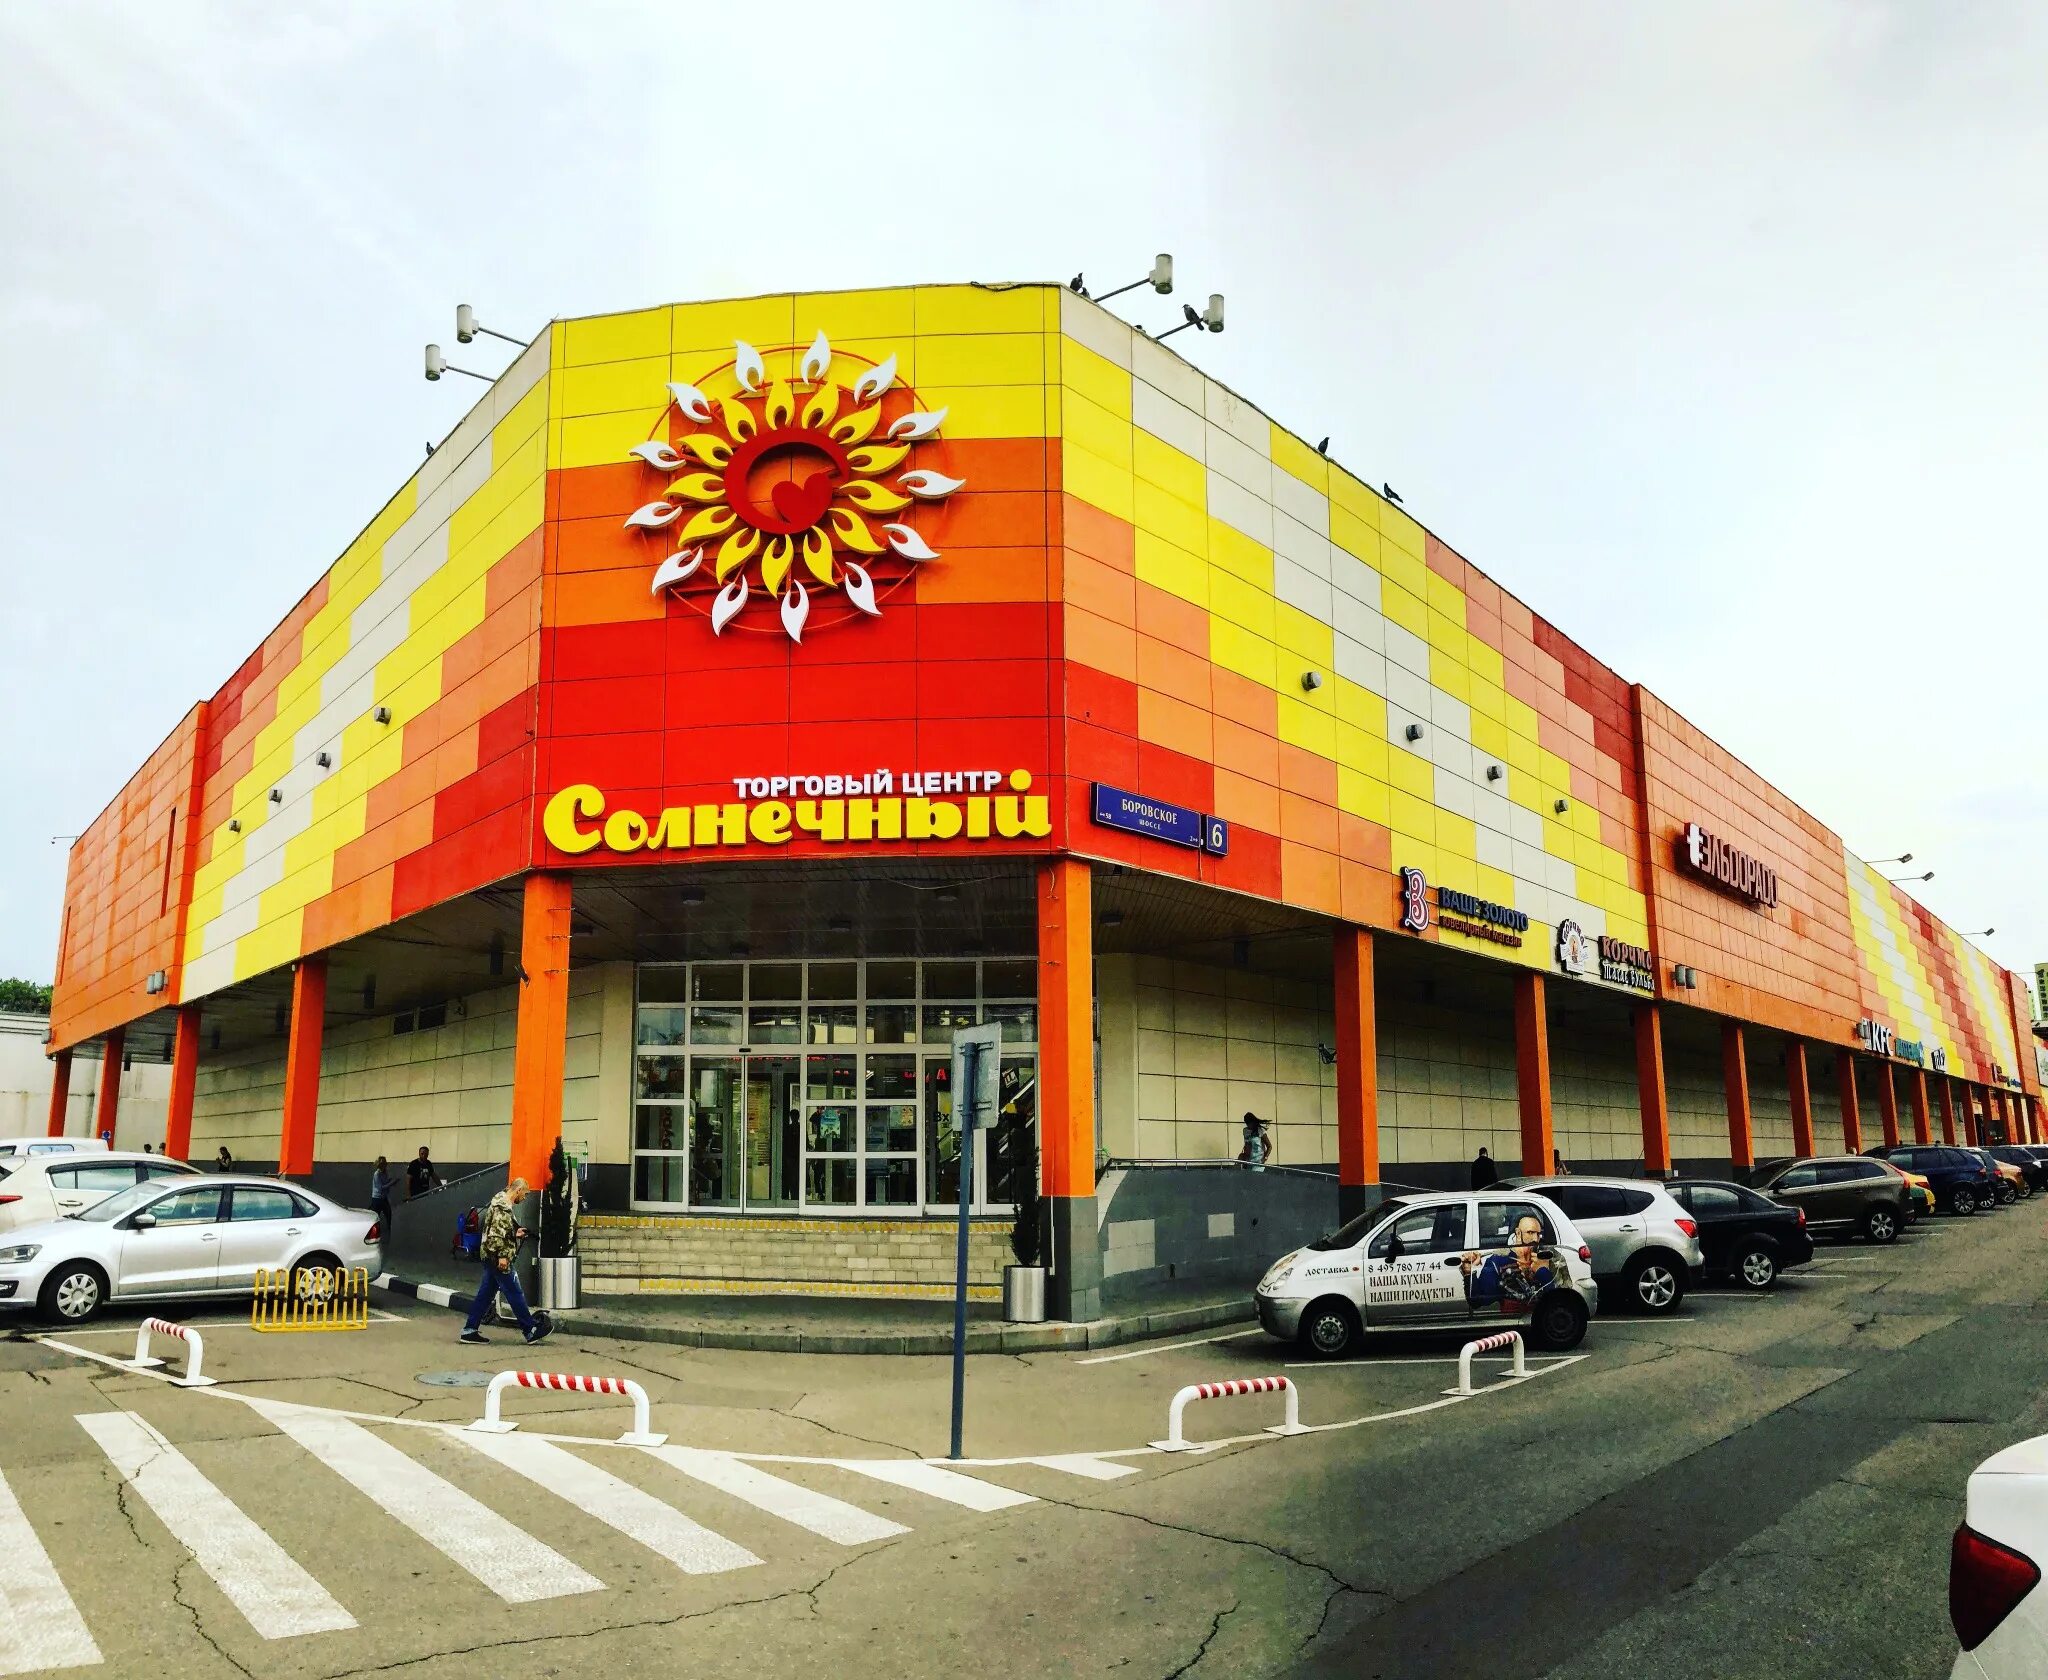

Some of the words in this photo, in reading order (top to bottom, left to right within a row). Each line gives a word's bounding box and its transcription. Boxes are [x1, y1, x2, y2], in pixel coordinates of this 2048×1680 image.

[733, 768, 893, 798] ТОРГОВЫЙ
[902, 770, 1002, 797] ЦЕНТР
[543, 769, 1053, 854] Солнечный
[1122, 799, 1178, 825] БОРОВСКОЕ
[1212, 824, 1223, 848] 6
[1440, 887, 1480, 917] ВАШЕ
[1481, 900, 1529, 932] ЗОЛОТО
[1872, 1021, 1894, 1057] KFC
[1368, 1264, 1374, 1273] 8
[1377, 1263, 1394, 1273] 495
[1396, 1263, 1413, 1272] 780
[1416, 1262, 1426, 1272] 77
[1429, 1261, 1441, 1270] 44
[1370, 1275, 1399, 1288] НАША
[1400, 1273, 1433, 1288] КУХНЯ
[1370, 1290, 1401, 1303] НАШИ
[1402, 1287, 1455, 1303] ПРОДУКТЫ
